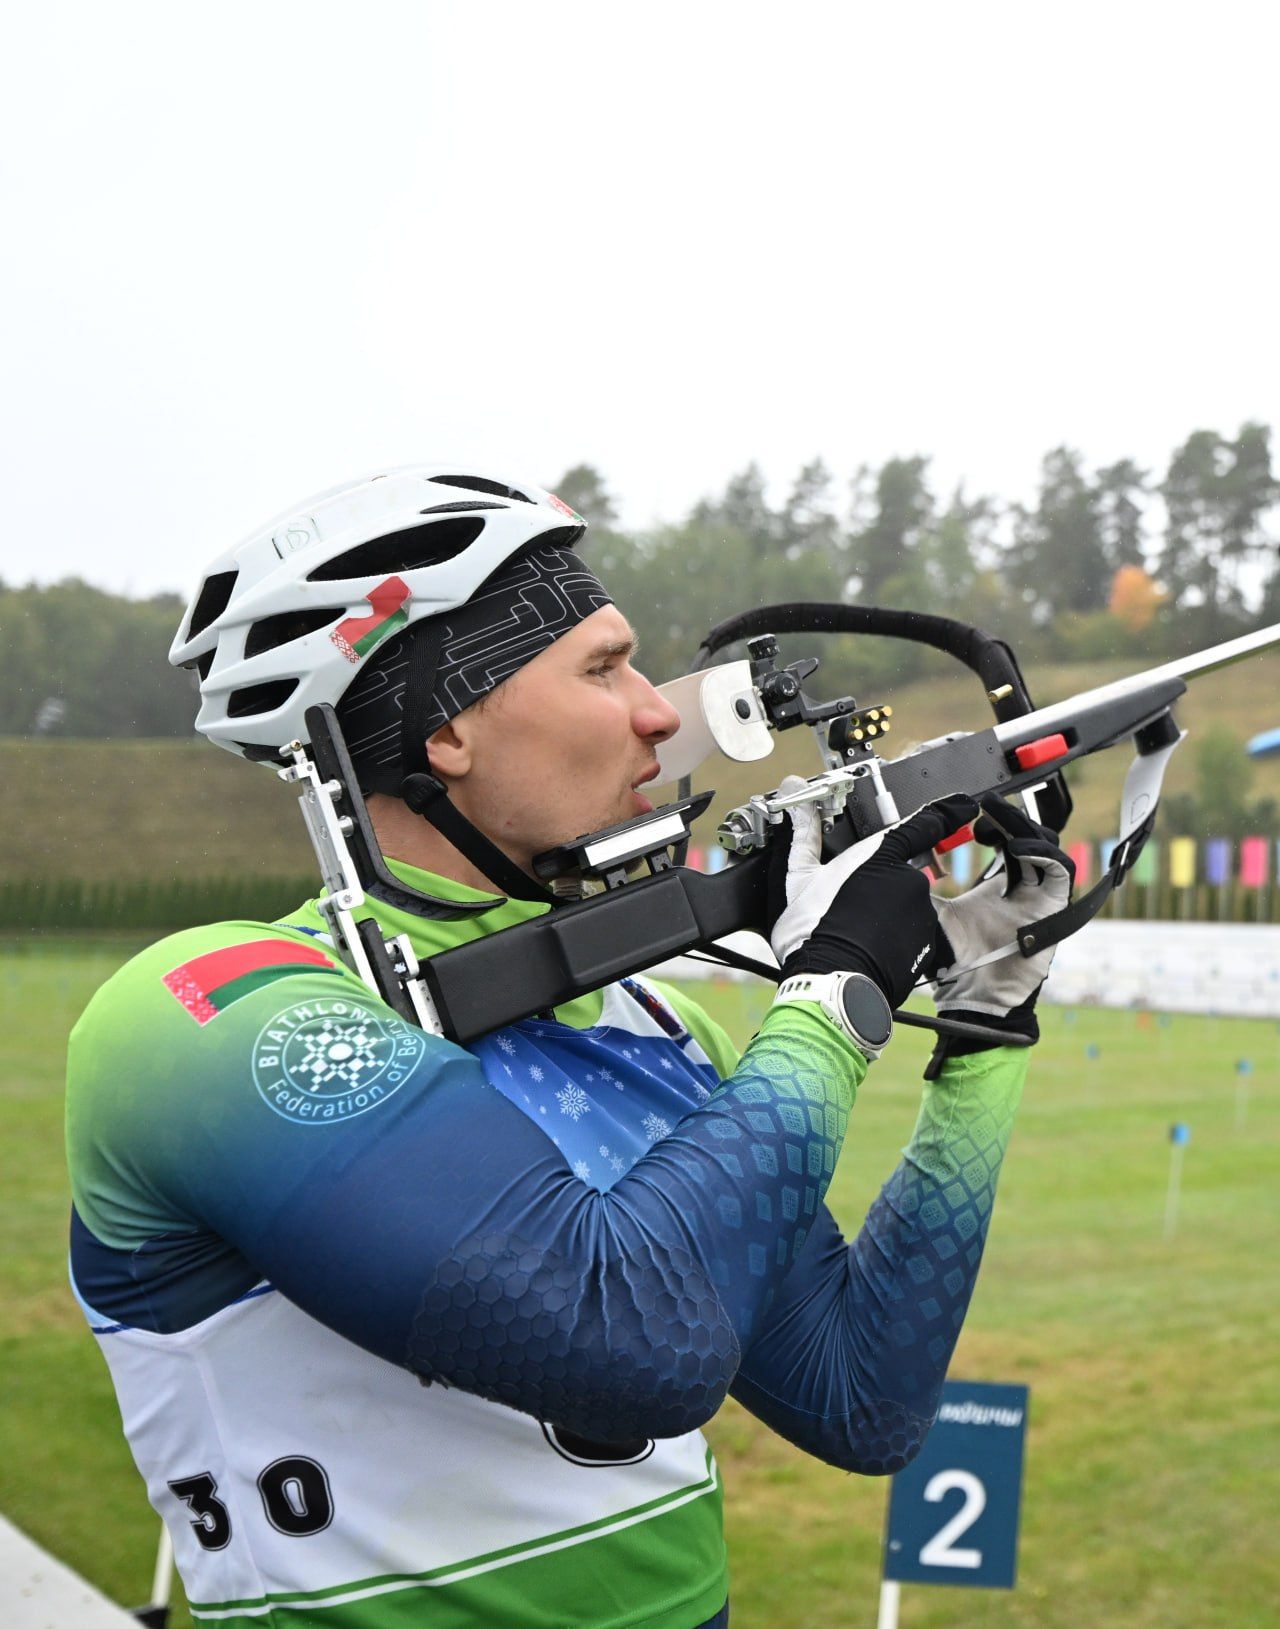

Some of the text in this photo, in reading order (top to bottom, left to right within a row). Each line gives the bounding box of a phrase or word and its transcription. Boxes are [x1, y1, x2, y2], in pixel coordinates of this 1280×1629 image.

[258, 1002, 368, 1069] BIATHLON
[267, 1078, 384, 1118] Federation
[387, 1060, 409, 1081] of
[919, 1468, 987, 1569] 2
